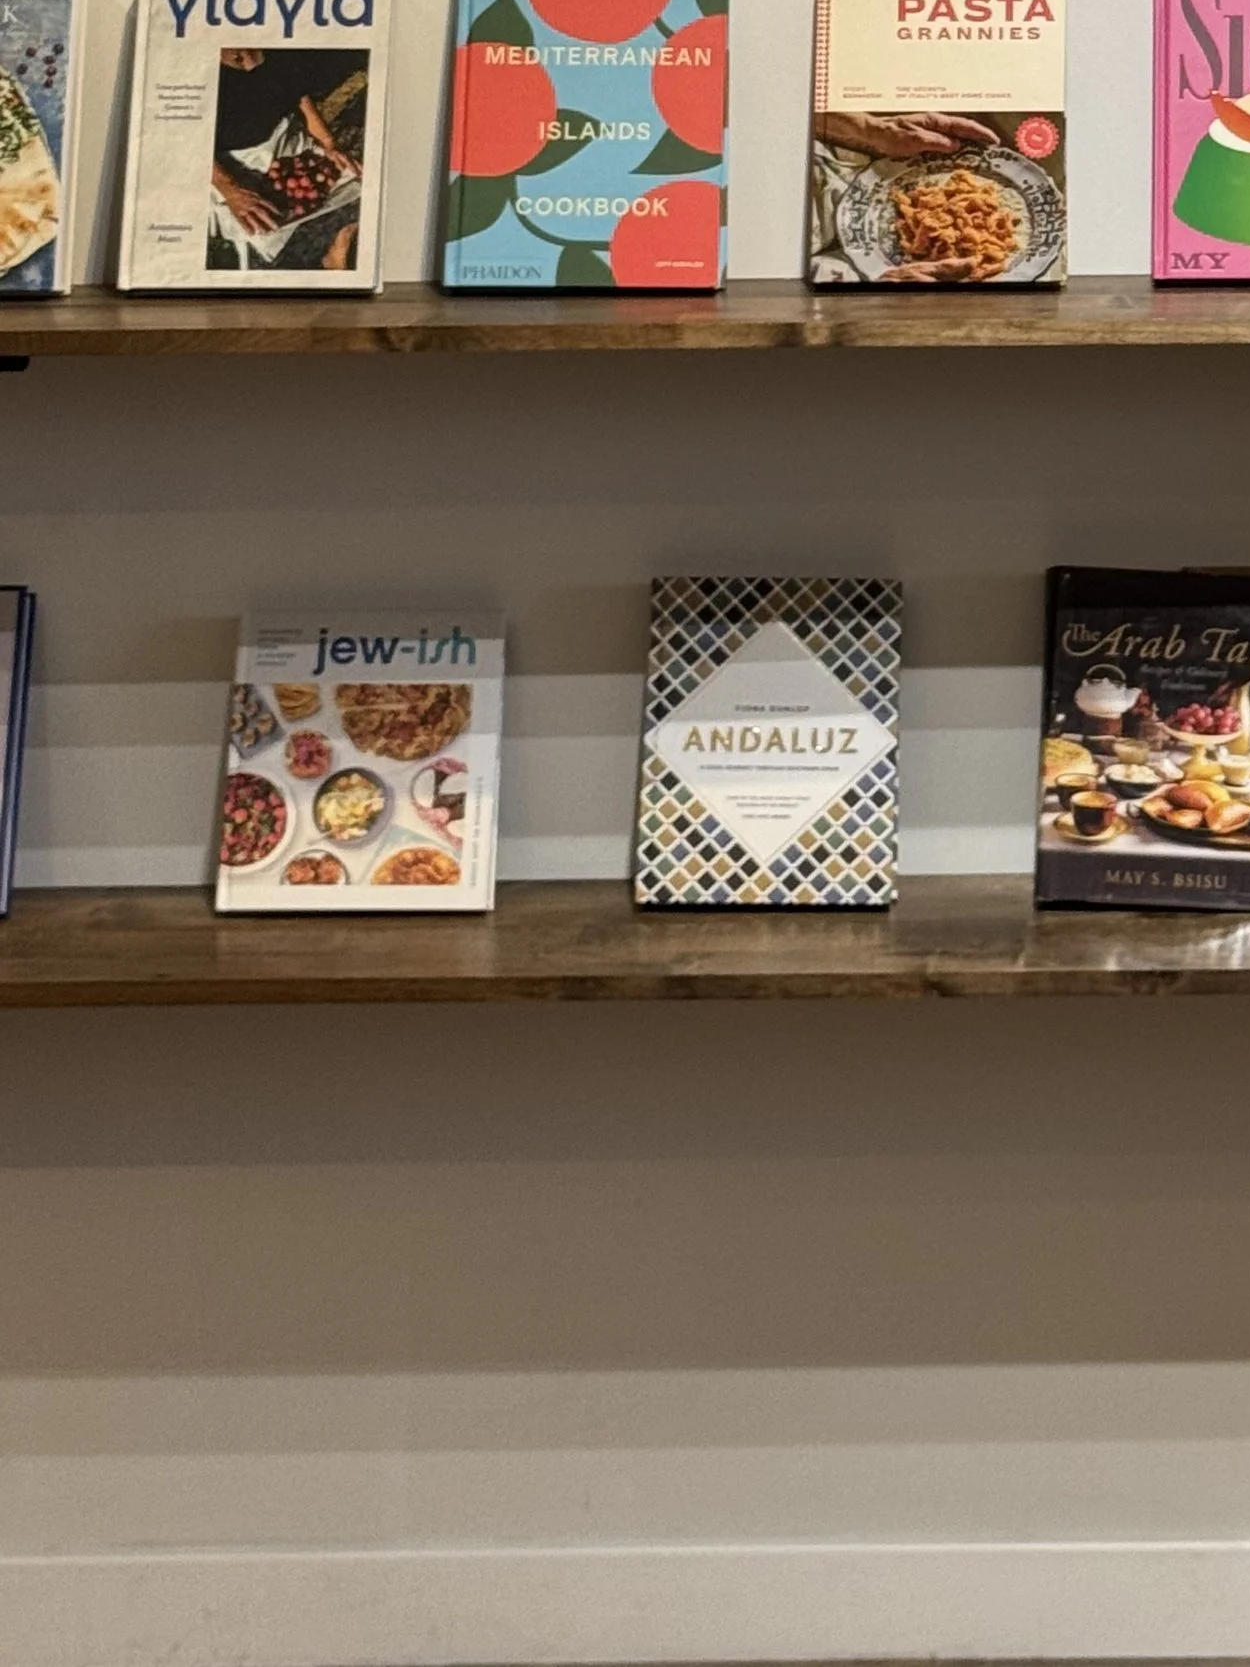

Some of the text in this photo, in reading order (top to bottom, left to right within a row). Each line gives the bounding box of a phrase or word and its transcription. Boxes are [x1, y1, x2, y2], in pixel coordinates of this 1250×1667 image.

[897, 27, 1041, 40] GRANNIES
[485, 46, 712, 66] MEDITERRANEAN
[539, 121, 651, 141] ISLANDS
[516, 197, 669, 217] COOKBOOK
[1171, 253, 1230, 270] MY
[463, 265, 542, 279] PHAIDON
[1062, 623, 1186, 659] Arab
[1067, 623, 1099, 642] The
[313, 626, 477, 675] jew-ish
[682, 725, 859, 754] ANDALUZ
[1105, 870, 1145, 885] MAY
